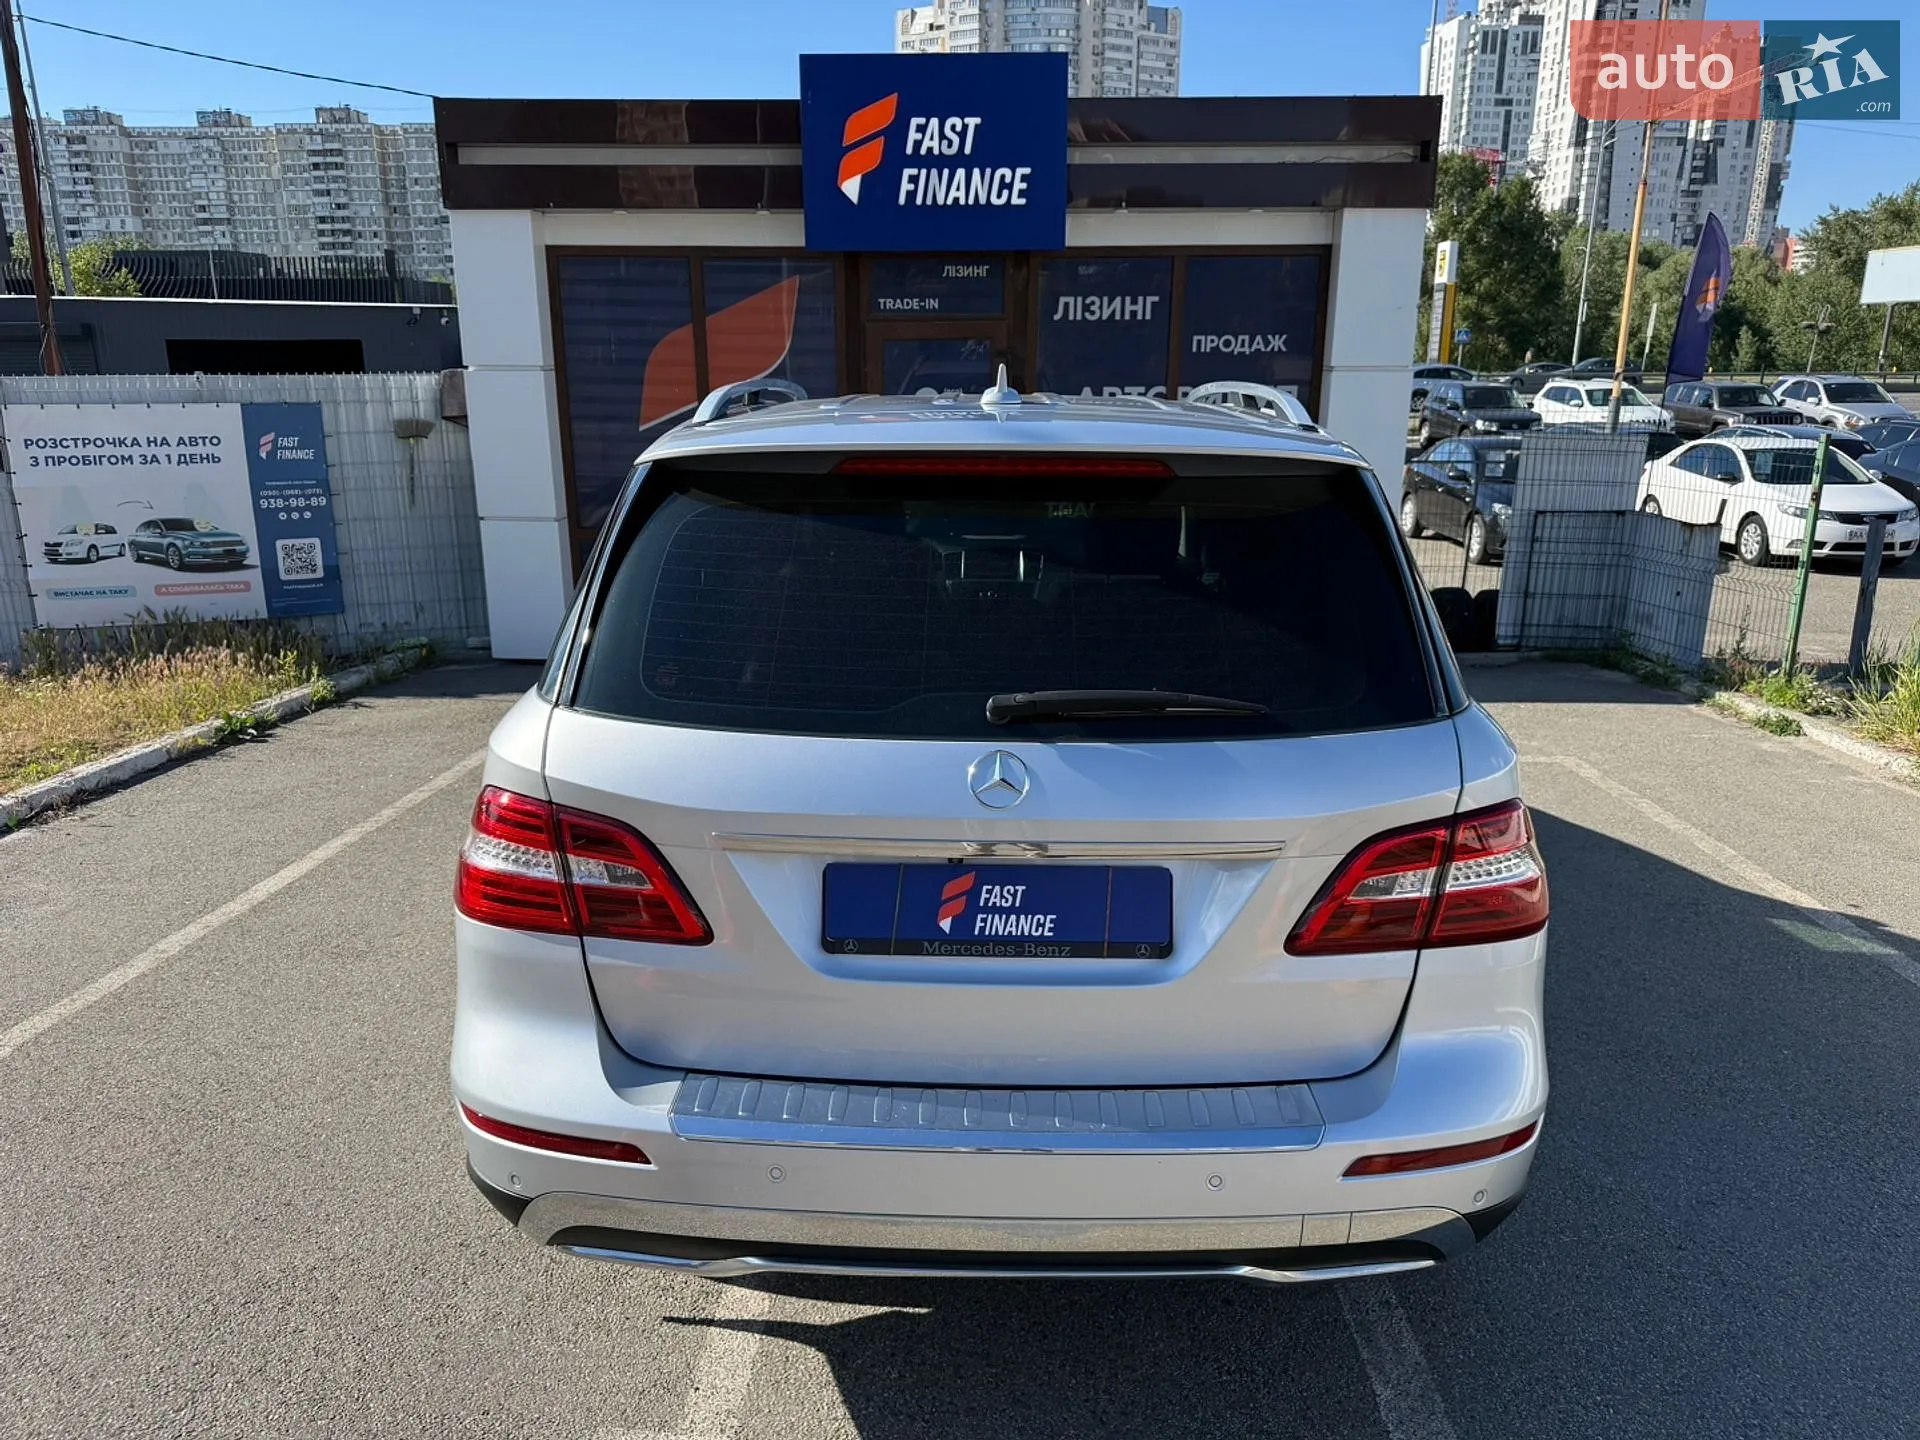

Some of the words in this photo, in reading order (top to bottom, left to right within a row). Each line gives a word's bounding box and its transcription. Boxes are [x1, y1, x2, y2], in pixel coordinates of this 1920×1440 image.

[905, 117, 982, 155] FAST
[898, 167, 1032, 206] FINANCE
[942, 265, 990, 278] ЛІЗИНГ
[878, 298, 939, 310] TRADE-IN
[1053, 295, 1160, 321] ЛІЗИНГ
[1192, 334, 1287, 354] ПРОДАЖ
[23, 437, 142, 449] РОЗСТРОЧКА
[146, 436, 172, 448] НА
[176, 435, 222, 448] АВТО
[278, 437, 299, 447] FAST
[45, 454, 134, 467] ПРОБІГОМ
[139, 453, 161, 466] ЗА
[165, 453, 172, 465] 1
[177, 453, 222, 467] ДЕНЬ
[277, 449, 315, 460] FINANCE
[260, 496, 327, 508] 938-98-89
[979, 885, 1026, 908] FAST
[974, 914, 1057, 936] FINANCE
[921, 941, 1071, 958] Mercedes-Benz
